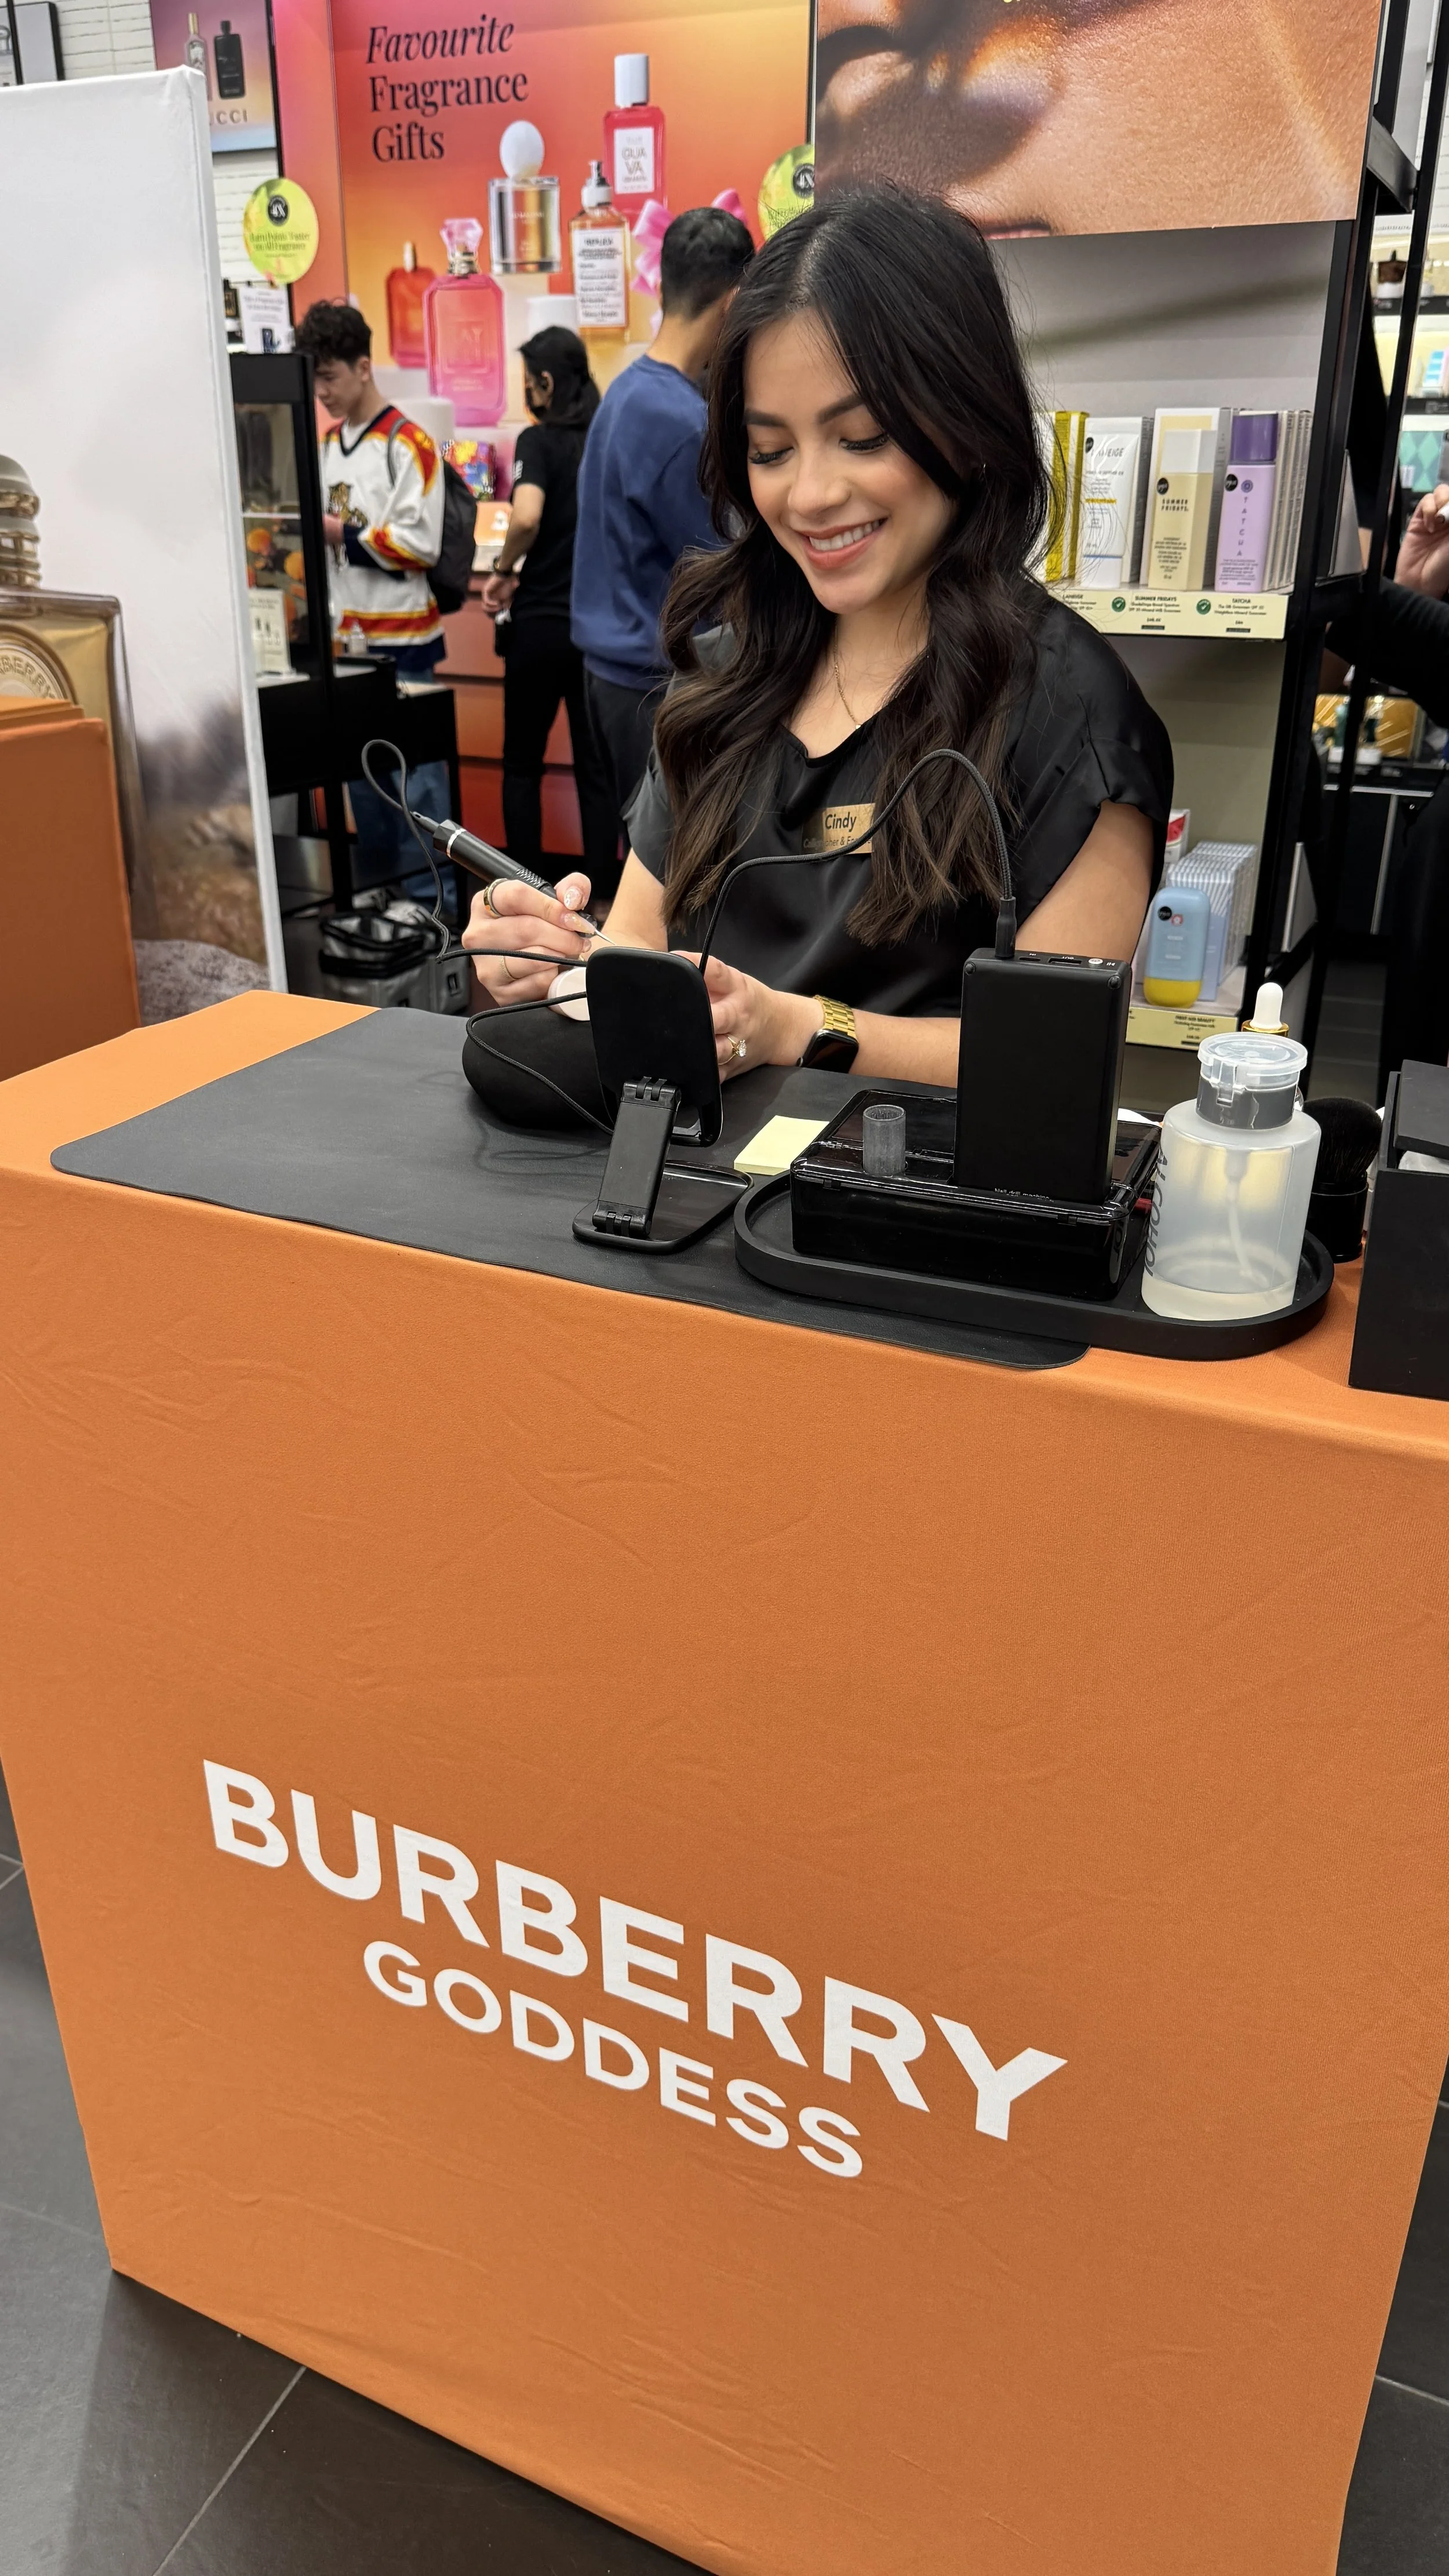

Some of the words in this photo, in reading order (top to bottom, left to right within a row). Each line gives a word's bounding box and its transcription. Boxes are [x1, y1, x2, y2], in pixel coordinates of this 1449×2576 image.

[366, 13, 515, 64] Favourite
[369, 73, 529, 118] Fragrance
[372, 121, 445, 163] Gifts
[825, 812, 857, 832] Cindy
[840, 836, 844, 846] &
[203, 1759, 1068, 2141] BURBERRY
[363, 1940, 863, 2177] GODDESS
